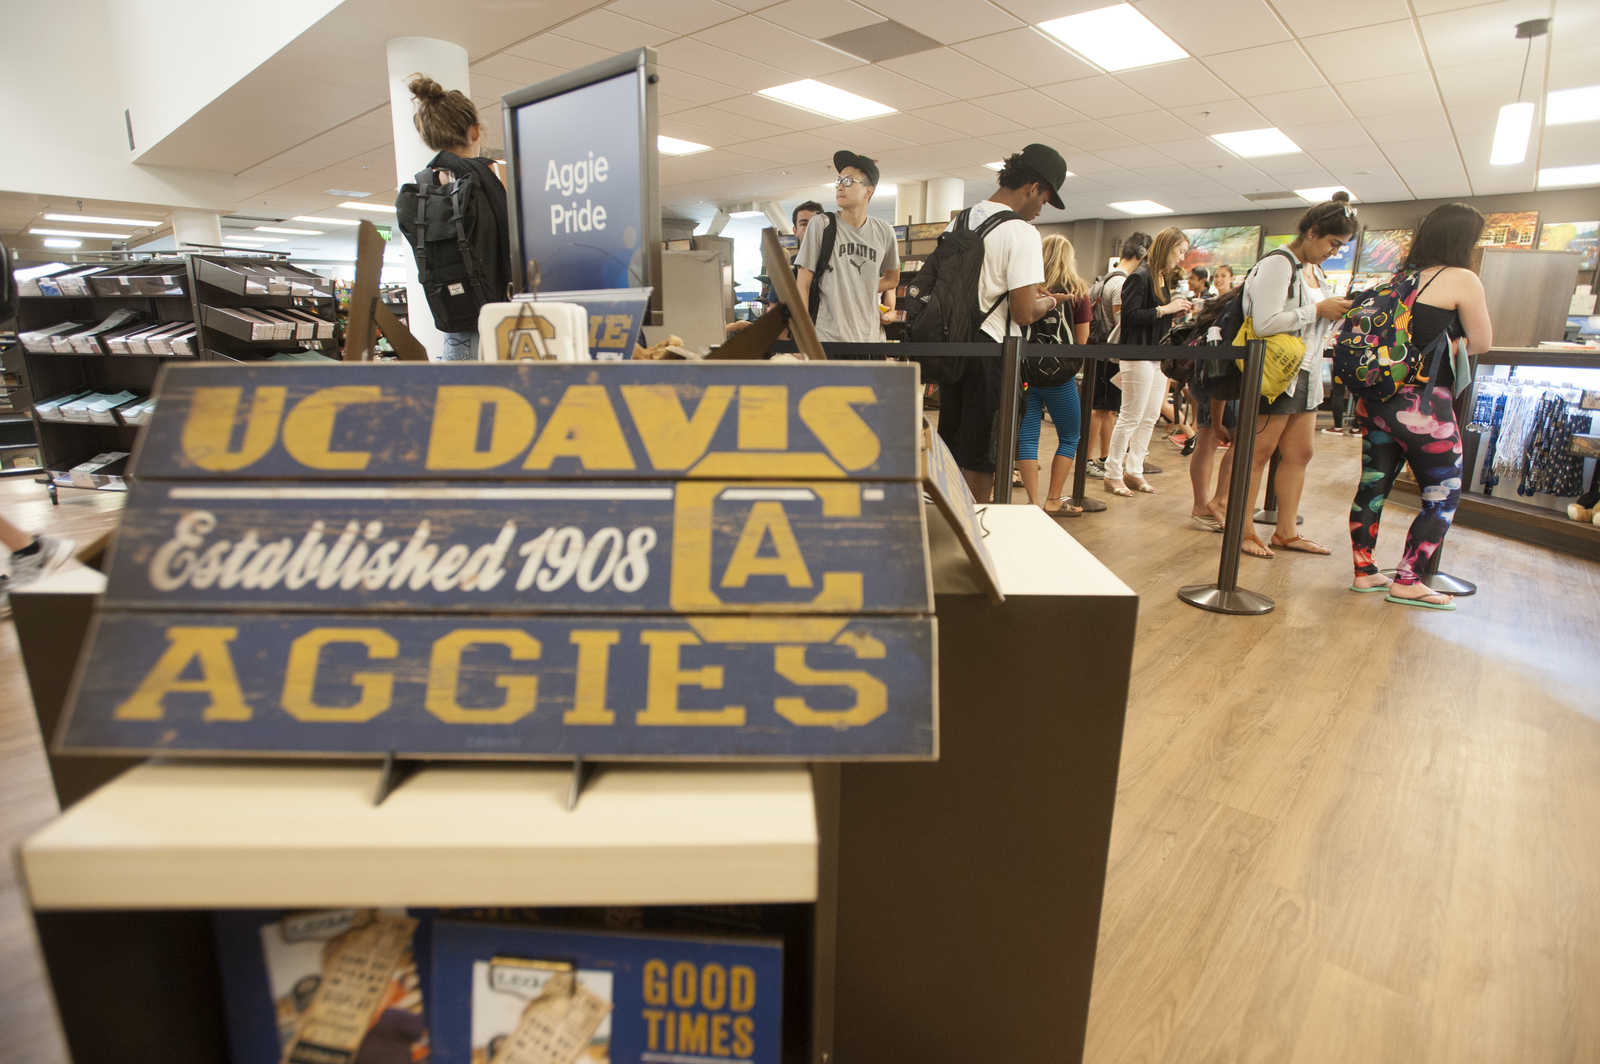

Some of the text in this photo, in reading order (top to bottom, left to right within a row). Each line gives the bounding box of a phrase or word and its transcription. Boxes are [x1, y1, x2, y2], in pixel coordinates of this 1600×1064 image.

[544, 150, 609, 197] Aggie
[550, 199, 607, 235] Pride
[839, 242, 877, 263] PUMA
[181, 384, 882, 472] UC DAVIS
[147, 510, 658, 593] Established 1908
[113, 625, 890, 727] AGGIES
[642, 958, 757, 1012] GOOD
[642, 1008, 756, 1059] TIMES
